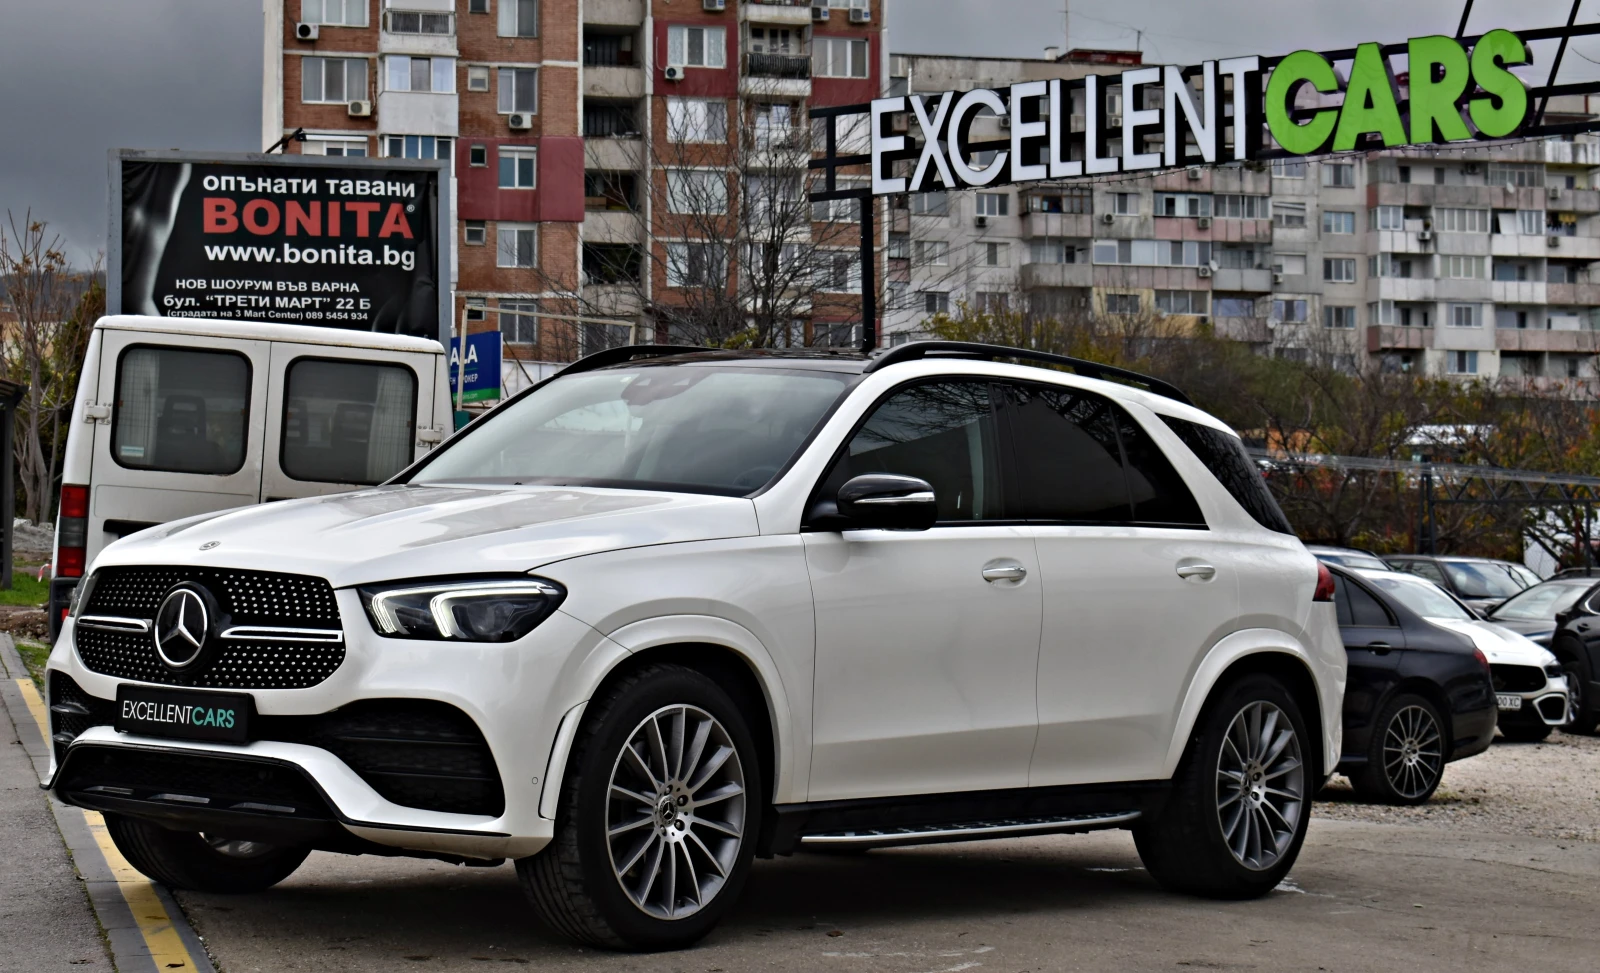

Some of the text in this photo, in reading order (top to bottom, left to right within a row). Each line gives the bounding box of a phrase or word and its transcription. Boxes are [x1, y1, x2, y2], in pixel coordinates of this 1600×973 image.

[202, 174, 416, 198] опънати тавани
[204, 243, 415, 271] www.bonita.bg
[175, 279, 360, 293] НОВ ШОУРУМ ВЪВ ВАРНА
[163, 295, 200, 309] бул.
[335, 298, 355, 310] 22
[359, 298, 371, 310] Б
[235, 309, 242, 317] 3
[243, 310, 266, 318] Mart
[268, 310, 304, 321] Center)
[305, 311, 323, 320] 089
[325, 312, 349, 320] 5454
[350, 312, 368, 321] 934
